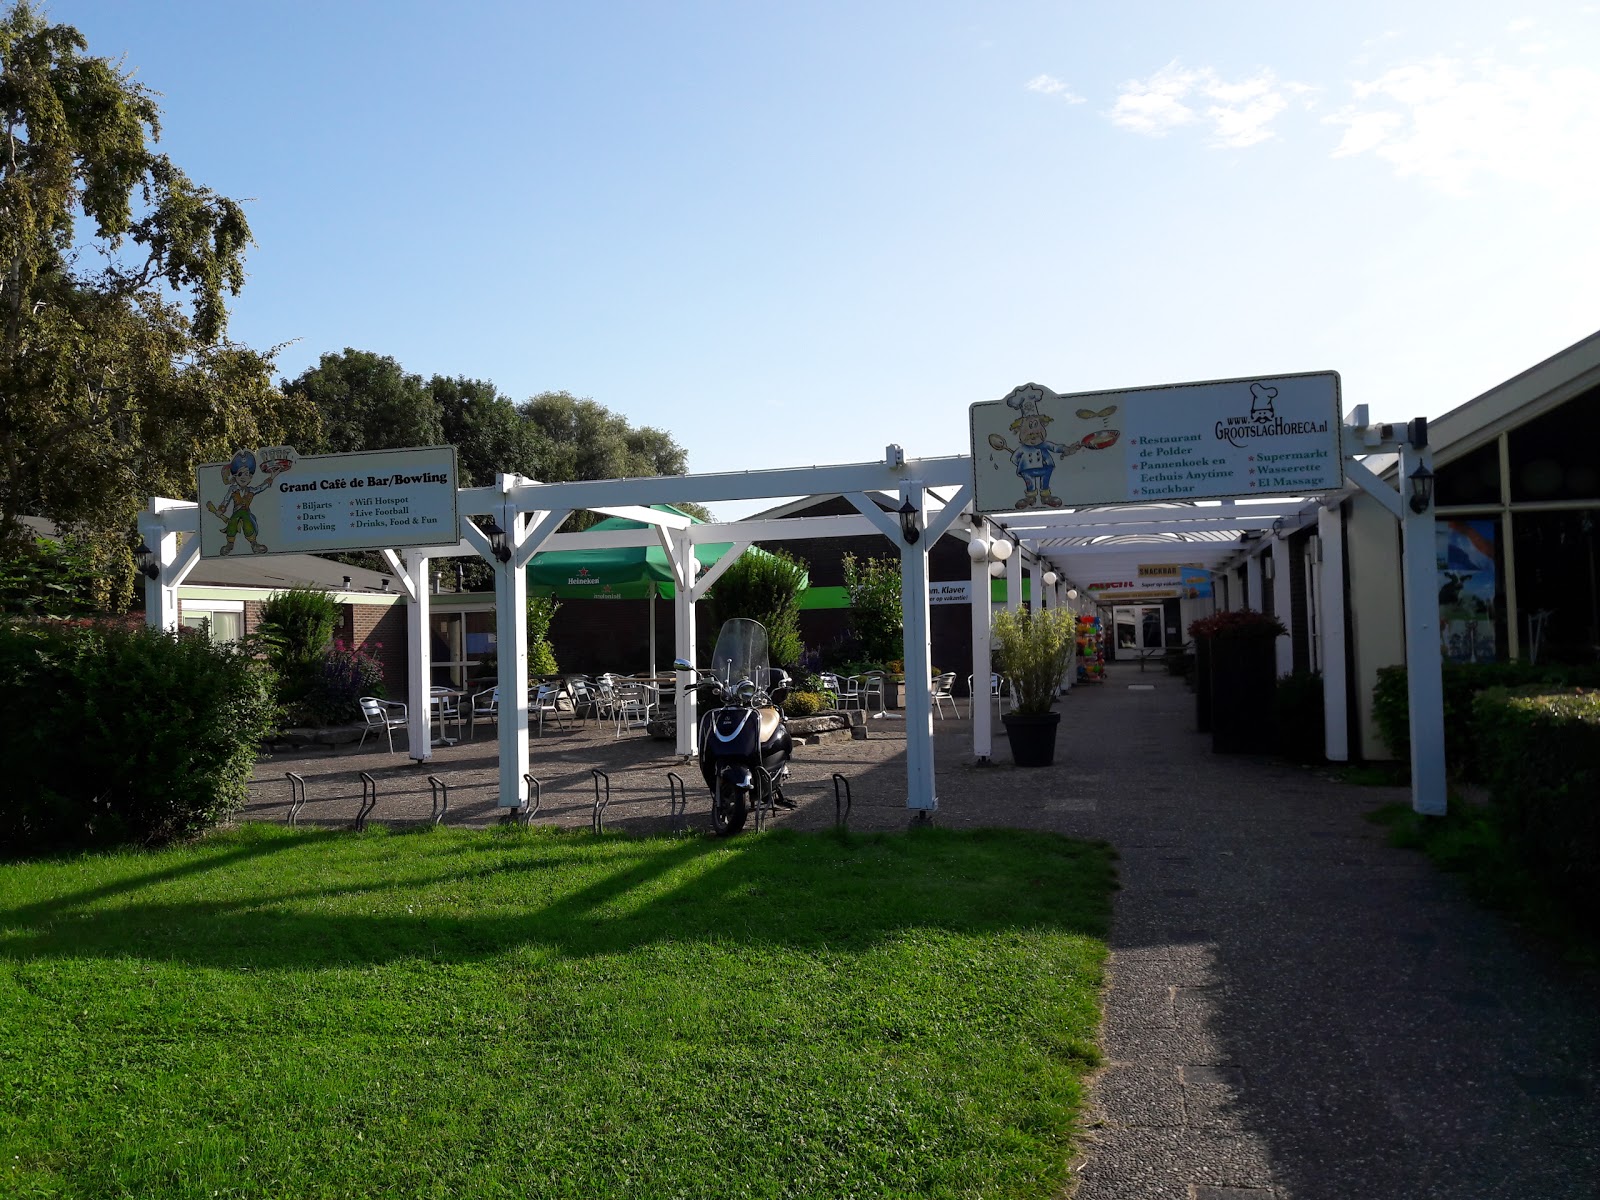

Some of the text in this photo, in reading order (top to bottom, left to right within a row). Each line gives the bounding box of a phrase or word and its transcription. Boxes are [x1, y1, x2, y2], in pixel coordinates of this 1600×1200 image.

[1139, 434, 1202, 445] Restaurant
[1140, 447, 1193, 457] de Polder
[1257, 450, 1328, 463] Supermarkt
[1140, 458, 1209, 470] Pannenkoek
[1257, 465, 1321, 475] Wasserette
[1141, 470, 1234, 482] Eethuis Anytime
[280, 473, 447, 493] Grand Café de Bar/Bowling
[1258, 477, 1324, 487] El Massage
[1141, 485, 1195, 495] Snackbar
[302, 502, 332, 511] Biljarts
[375, 507, 409, 515] Football
[1139, 567, 1176, 575] SNACKBAR
[568, 577, 600, 585] Heineken
